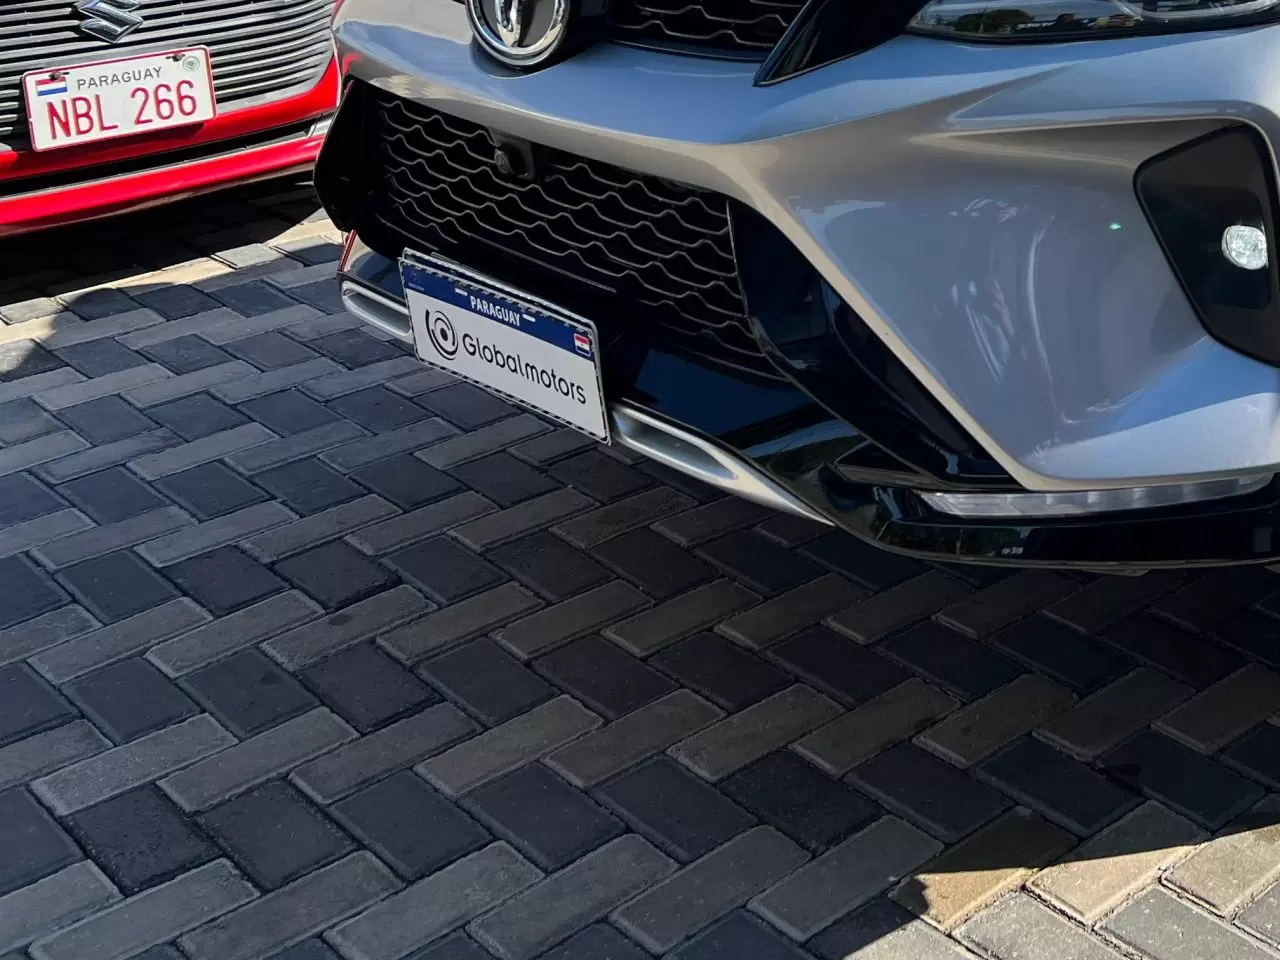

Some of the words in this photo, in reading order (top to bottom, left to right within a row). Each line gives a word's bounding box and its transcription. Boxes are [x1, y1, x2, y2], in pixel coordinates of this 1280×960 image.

[77, 66, 163, 90] PARAGUAY
[47, 94, 119, 140] NBL
[130, 79, 198, 125] 266
[469, 295, 521, 326] PARAGUAY
[462, 333, 587, 405] Globalmotors
